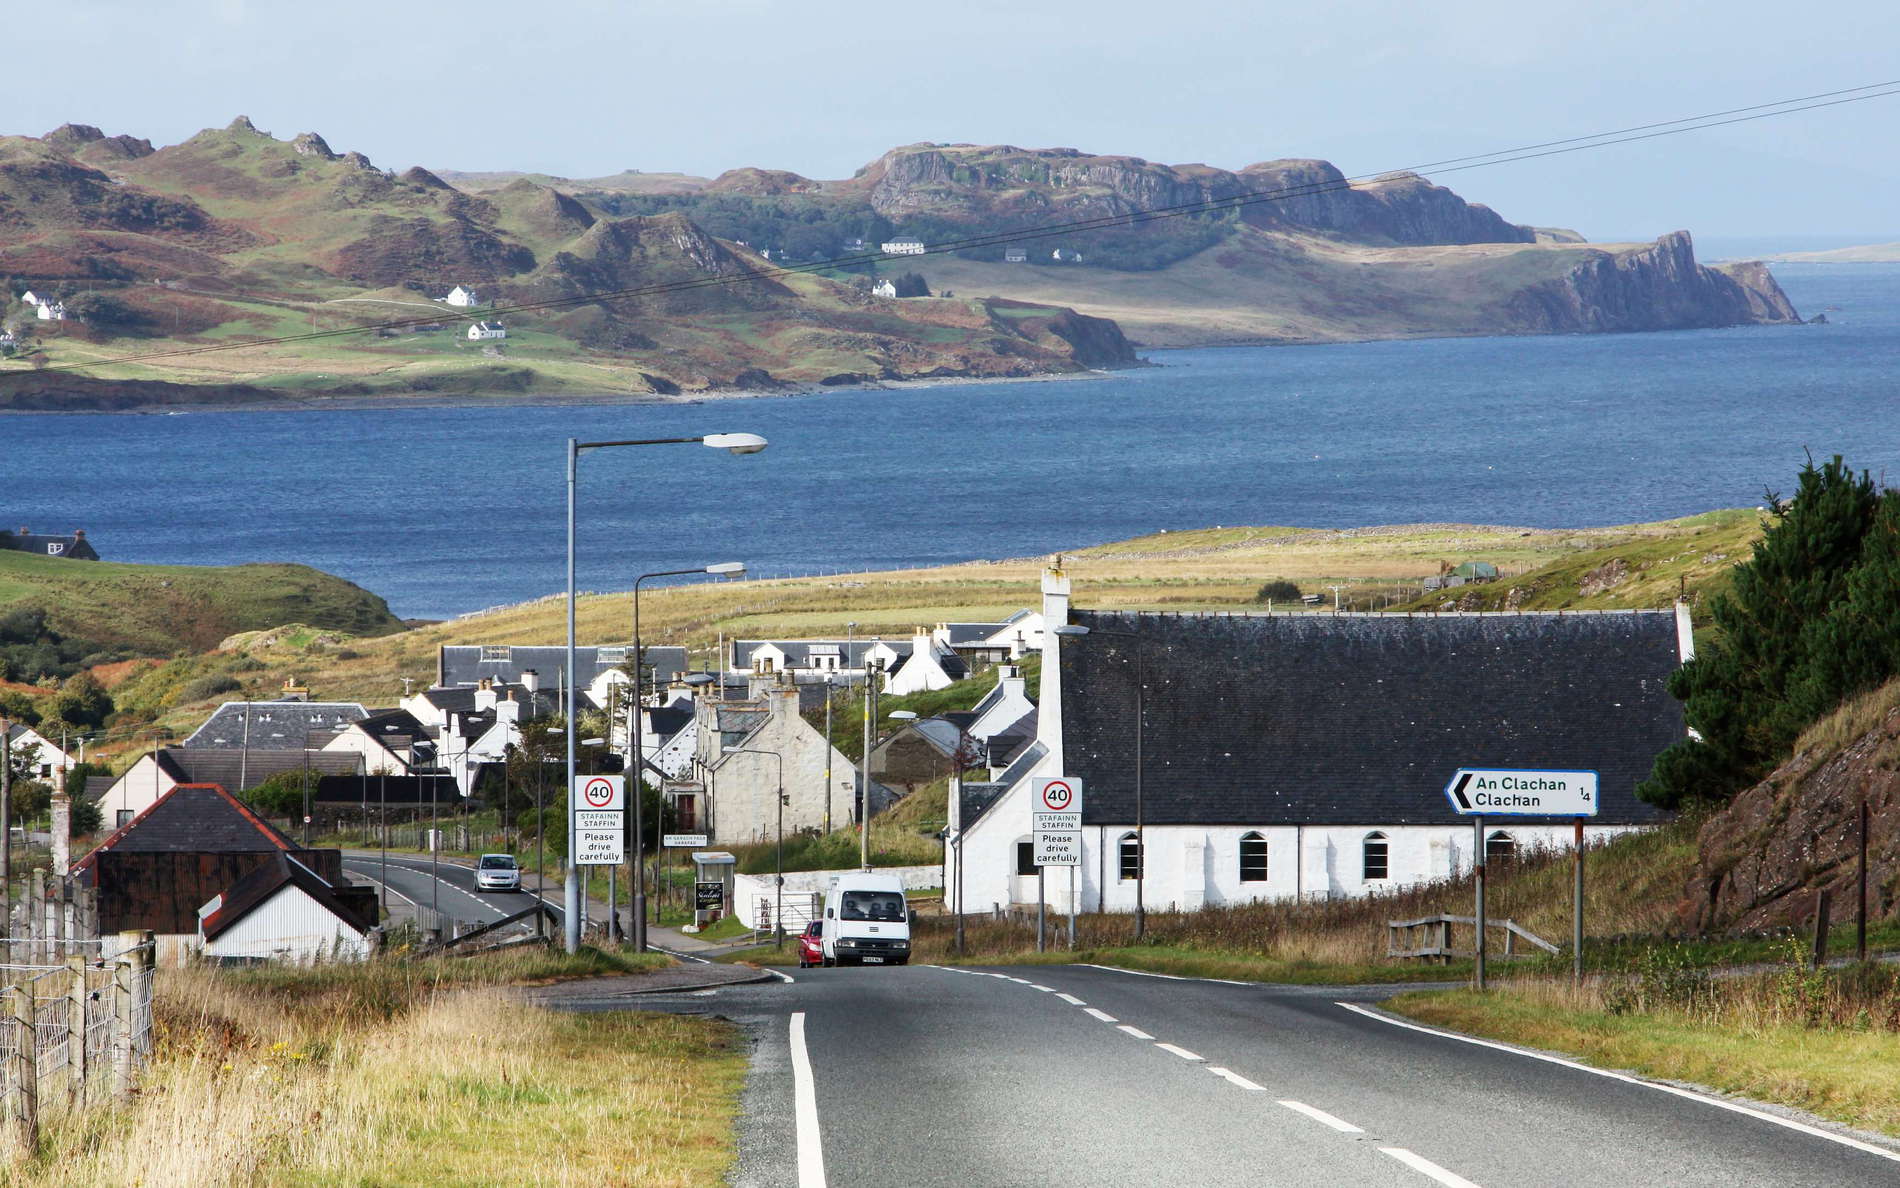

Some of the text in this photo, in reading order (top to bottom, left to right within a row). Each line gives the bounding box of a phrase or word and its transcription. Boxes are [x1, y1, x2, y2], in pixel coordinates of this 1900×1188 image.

[1476, 777, 1566, 790] An Clachan
[589, 786, 609, 798] 40
[1047, 789, 1068, 801] 40
[1475, 792, 1540, 807] Clachan
[580, 812, 619, 820] STAFAINN
[584, 833, 615, 841] Please
[1042, 834, 1072, 842] Please
[588, 843, 611, 851] drive
[1046, 844, 1069, 852] drive
[579, 852, 620, 862] carefully
[1036, 854, 1078, 863] carefully
